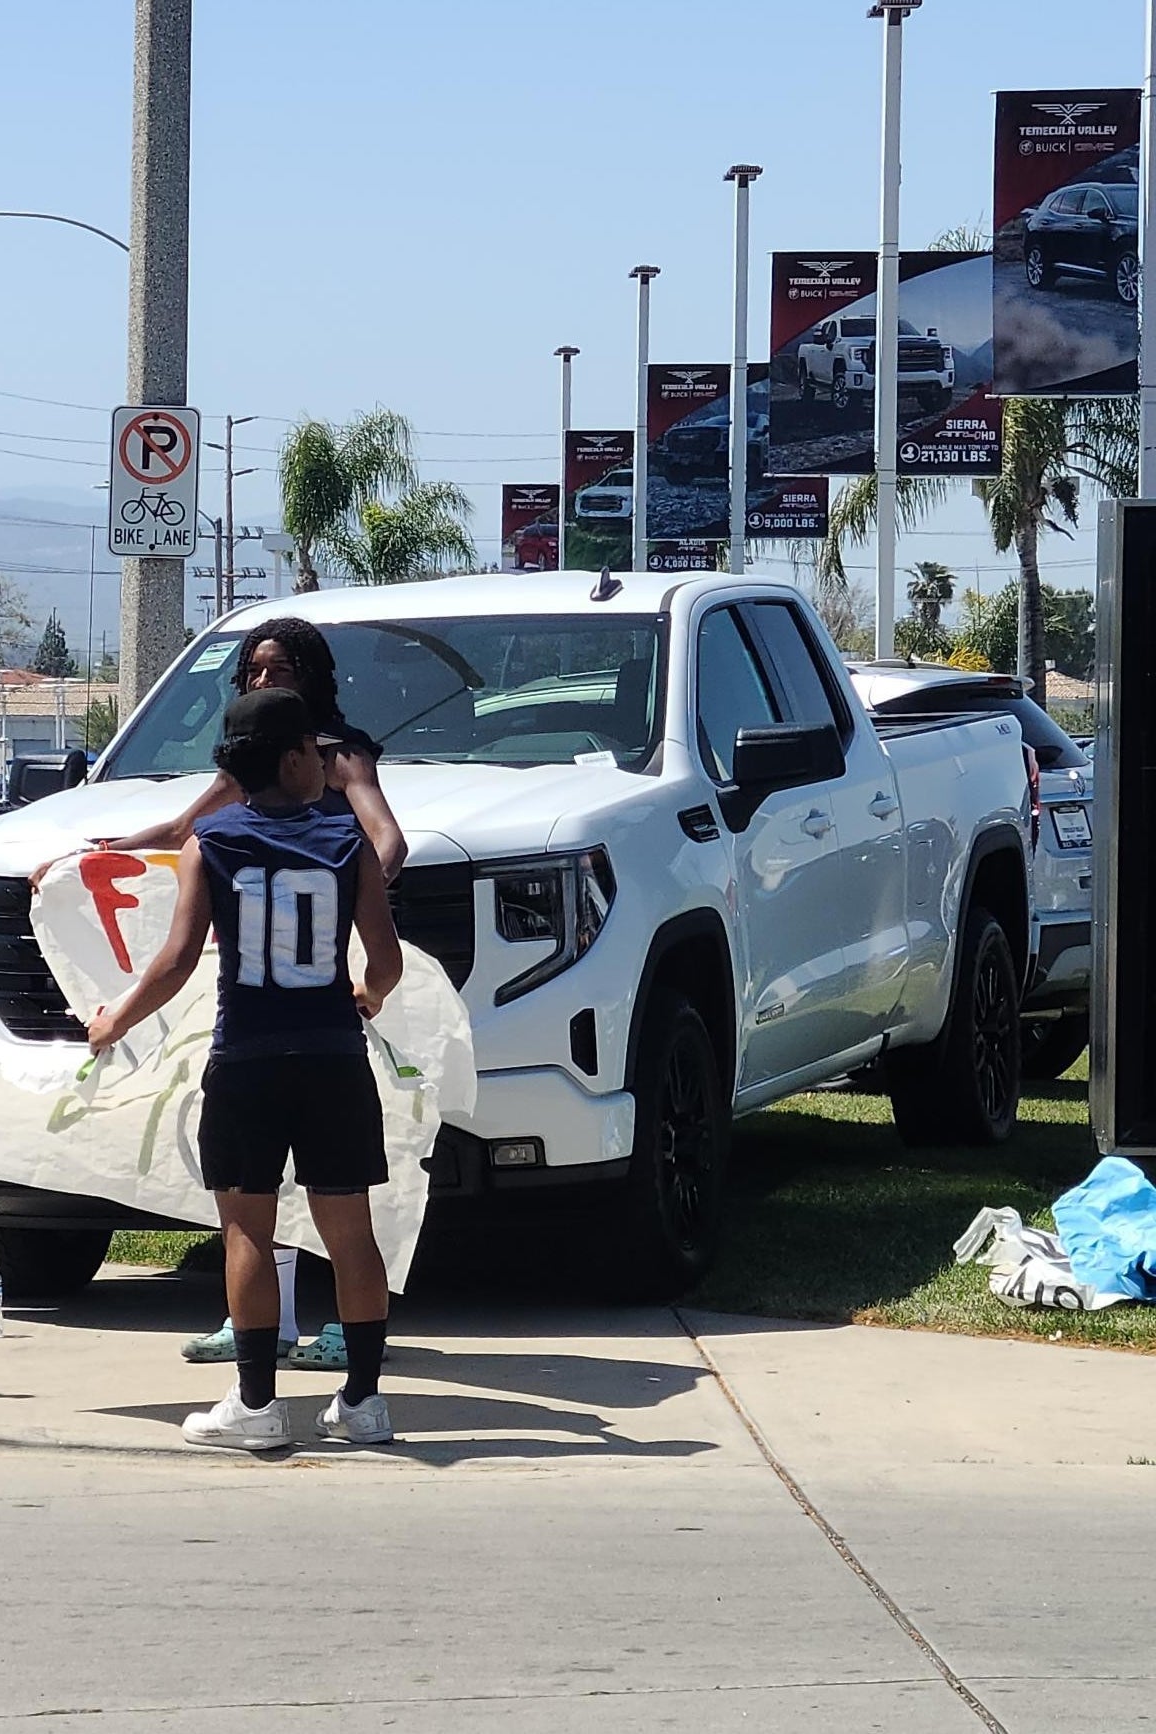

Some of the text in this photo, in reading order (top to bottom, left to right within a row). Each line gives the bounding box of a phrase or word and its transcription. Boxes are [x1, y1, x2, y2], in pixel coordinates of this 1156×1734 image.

[1019, 125, 1117, 136] TEMECULA VALLEY
[1035, 143, 1066, 152] BUICK
[800, 290, 823, 298] BUICK
[945, 419, 987, 429] SIERRA
[921, 450, 991, 464] 21,130 LBS.
[782, 494, 817, 502] SIERRA
[114, 528, 190, 545] BIKE LANE
[690, 560, 710, 569] LBS.
[233, 866, 338, 989] 10
